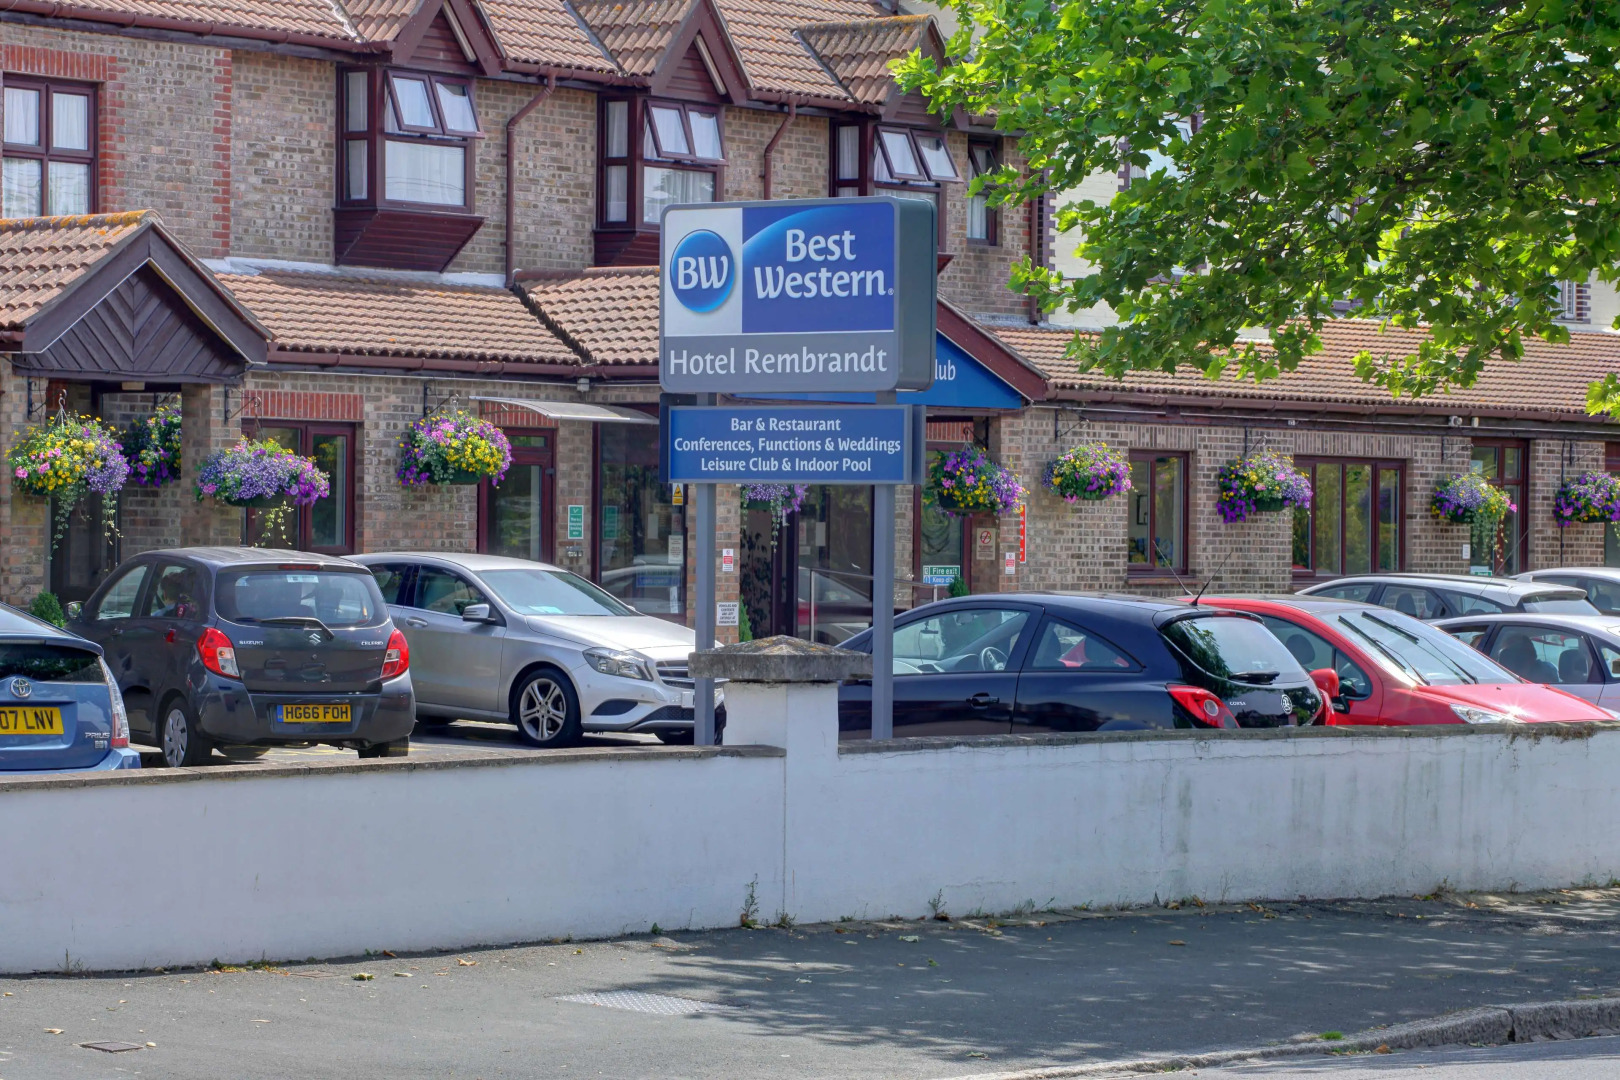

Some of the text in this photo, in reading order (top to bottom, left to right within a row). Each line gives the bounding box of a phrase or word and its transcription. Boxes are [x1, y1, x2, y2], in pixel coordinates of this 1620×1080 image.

[786, 228, 857, 262] Best
[677, 255, 729, 290] BW
[669, 344, 887, 375] Hotel Rembrandt
[934, 358, 956, 381] lub
[730, 417, 841, 431] Bar & Restaurant
[674, 437, 901, 454] Conferences, Functions & Weddings
[700, 457, 872, 472] Leisure Club & Indoor Pool
[932, 567, 958, 575] Fire exit
[23, 710, 55, 730] LNV
[285, 706, 320, 720] HG66
[322, 706, 349, 719] FOH
